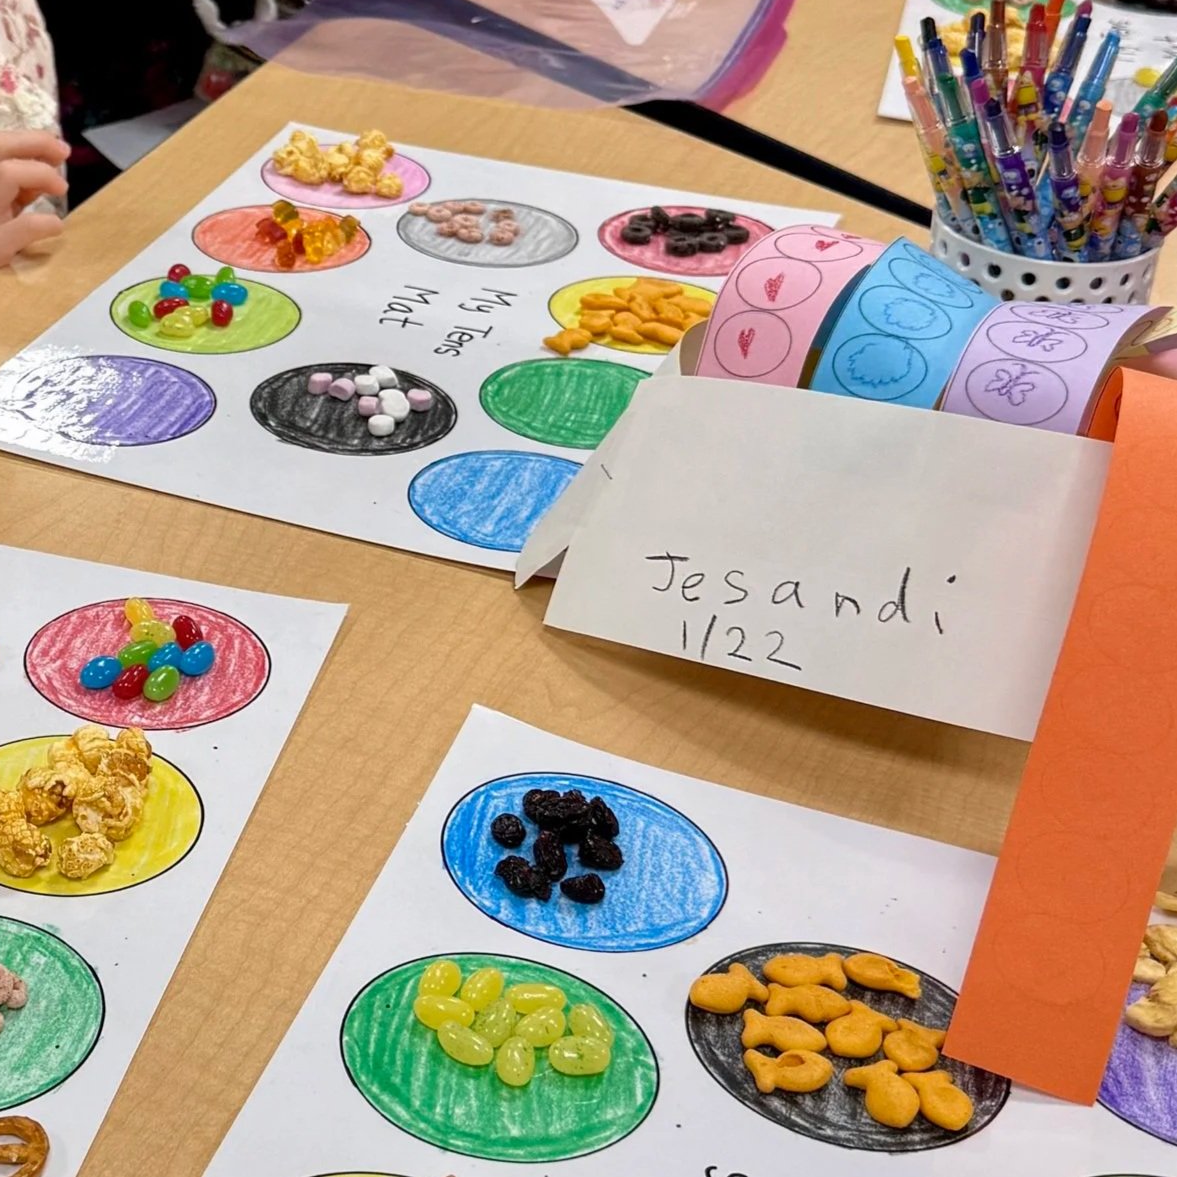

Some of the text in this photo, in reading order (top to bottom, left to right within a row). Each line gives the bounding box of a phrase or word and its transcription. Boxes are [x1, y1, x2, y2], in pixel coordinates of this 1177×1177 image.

[378, 284, 440, 328] Mat
[433, 287, 518, 357] My Tens
[645, 552, 956, 635] Jesandi
[681, 614, 802, 671] 1/22
